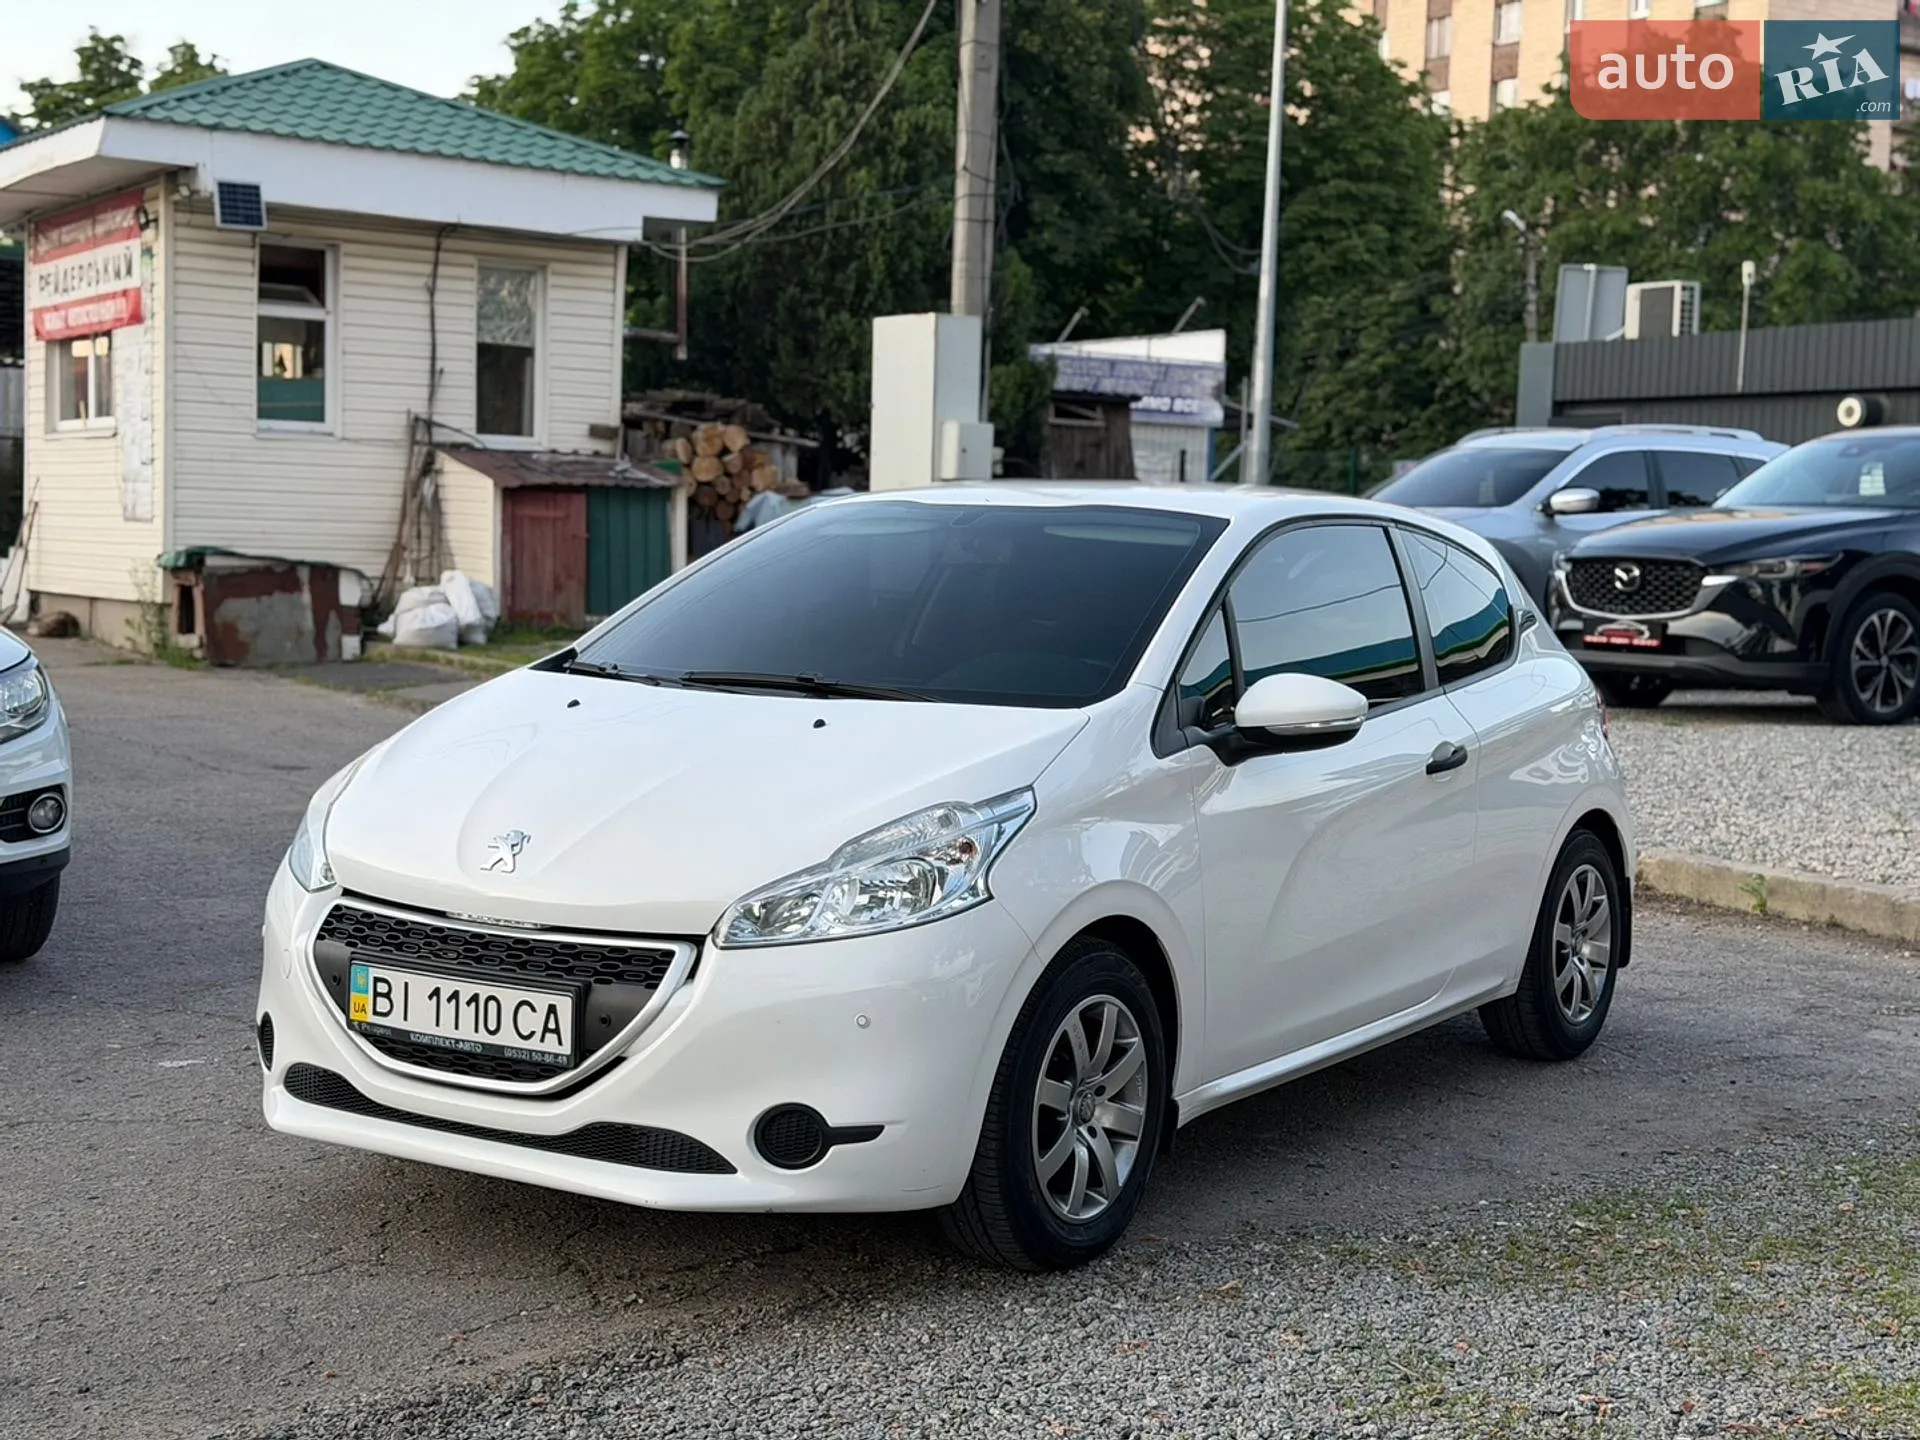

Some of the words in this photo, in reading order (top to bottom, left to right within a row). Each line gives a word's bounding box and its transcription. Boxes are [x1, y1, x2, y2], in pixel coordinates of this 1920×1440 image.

[353, 1001, 367, 1016] UA
[372, 976, 409, 1022] BI
[428, 987, 502, 1036] 1110
[512, 1000, 564, 1047] CA
